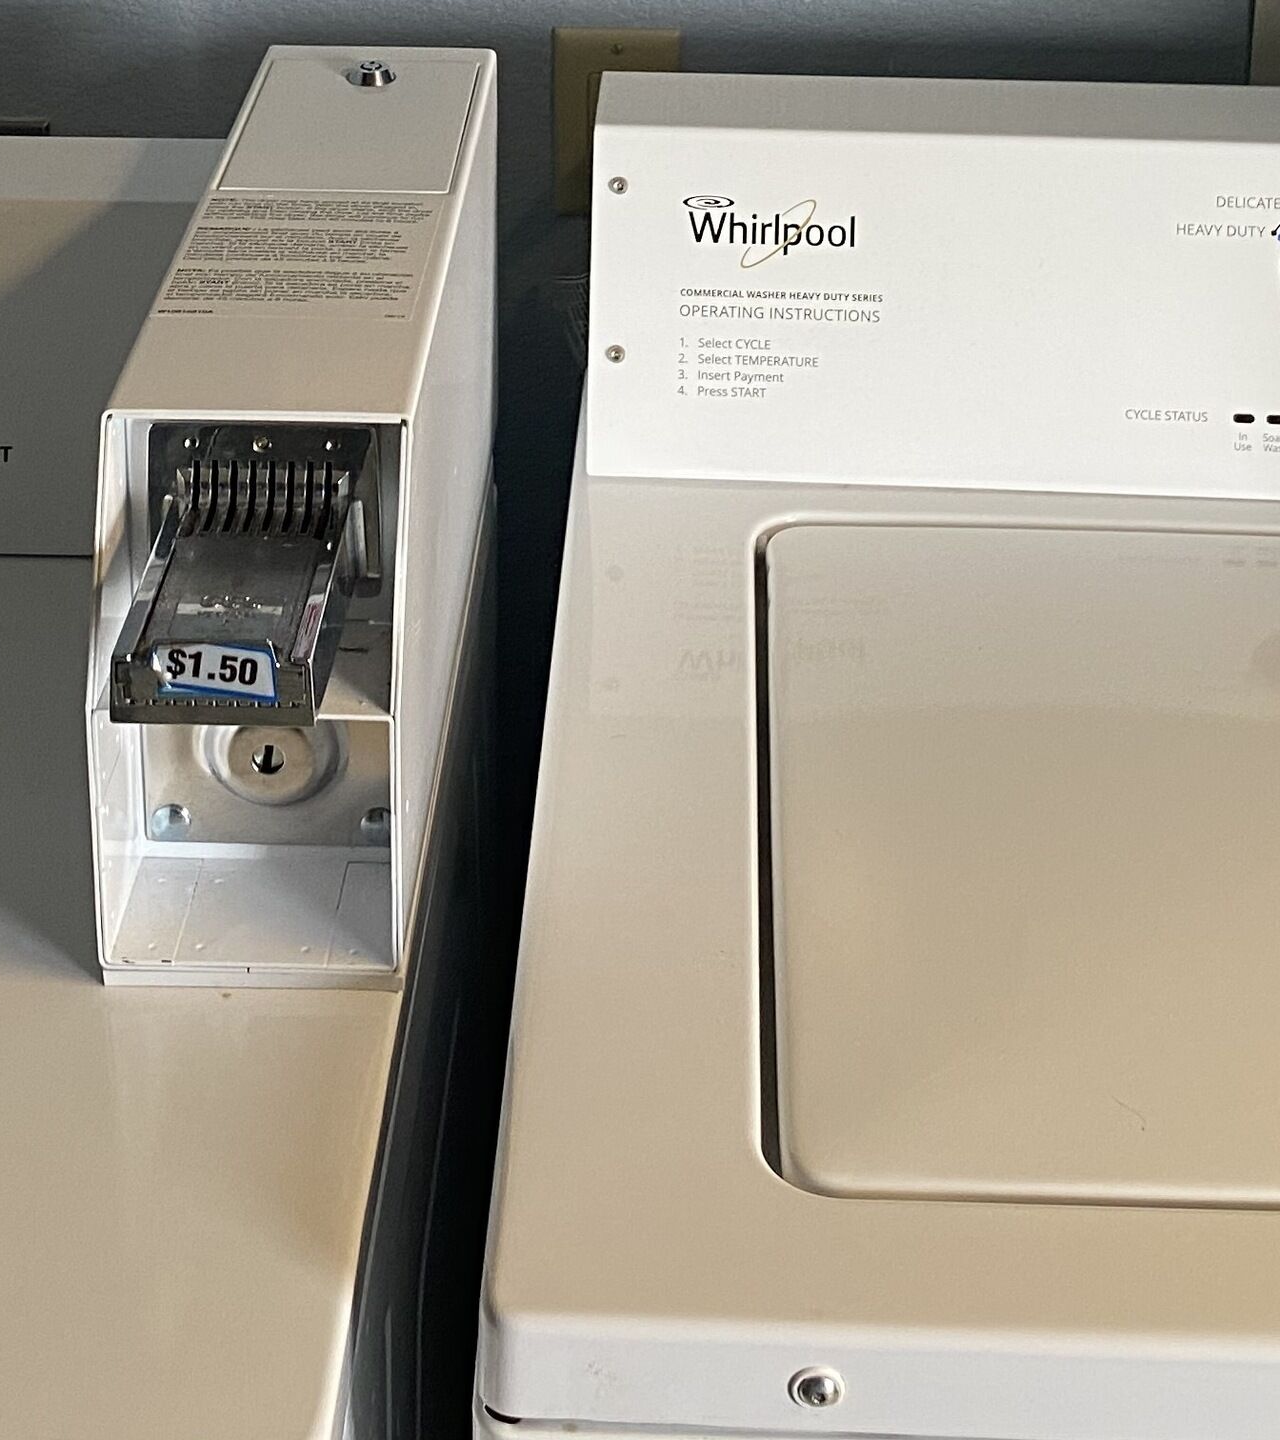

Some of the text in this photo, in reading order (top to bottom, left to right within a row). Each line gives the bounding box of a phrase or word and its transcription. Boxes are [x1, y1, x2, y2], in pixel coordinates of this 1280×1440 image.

[688, 211, 856, 256] Whirlpool
[1176, 224, 1266, 238] HEAVY DUTY
[680, 288, 884, 303] COMMERCIAL WASHER HEAVY DUTY SERIES
[679, 303, 881, 323] OPERATING INSTRUCTIONS
[679, 337, 771, 350] 1. Select CYCLE
[678, 353, 819, 368] 2. Select TEMPERATURE
[678, 369, 784, 387] 3. Insert Payment
[677, 386, 767, 398] 4. Press START
[1125, 410, 1208, 423] CYCLE STATUS
[1238, 433, 1247, 441] In
[1234, 442, 1252, 451] Use
[166, 648, 259, 686] $1.50
